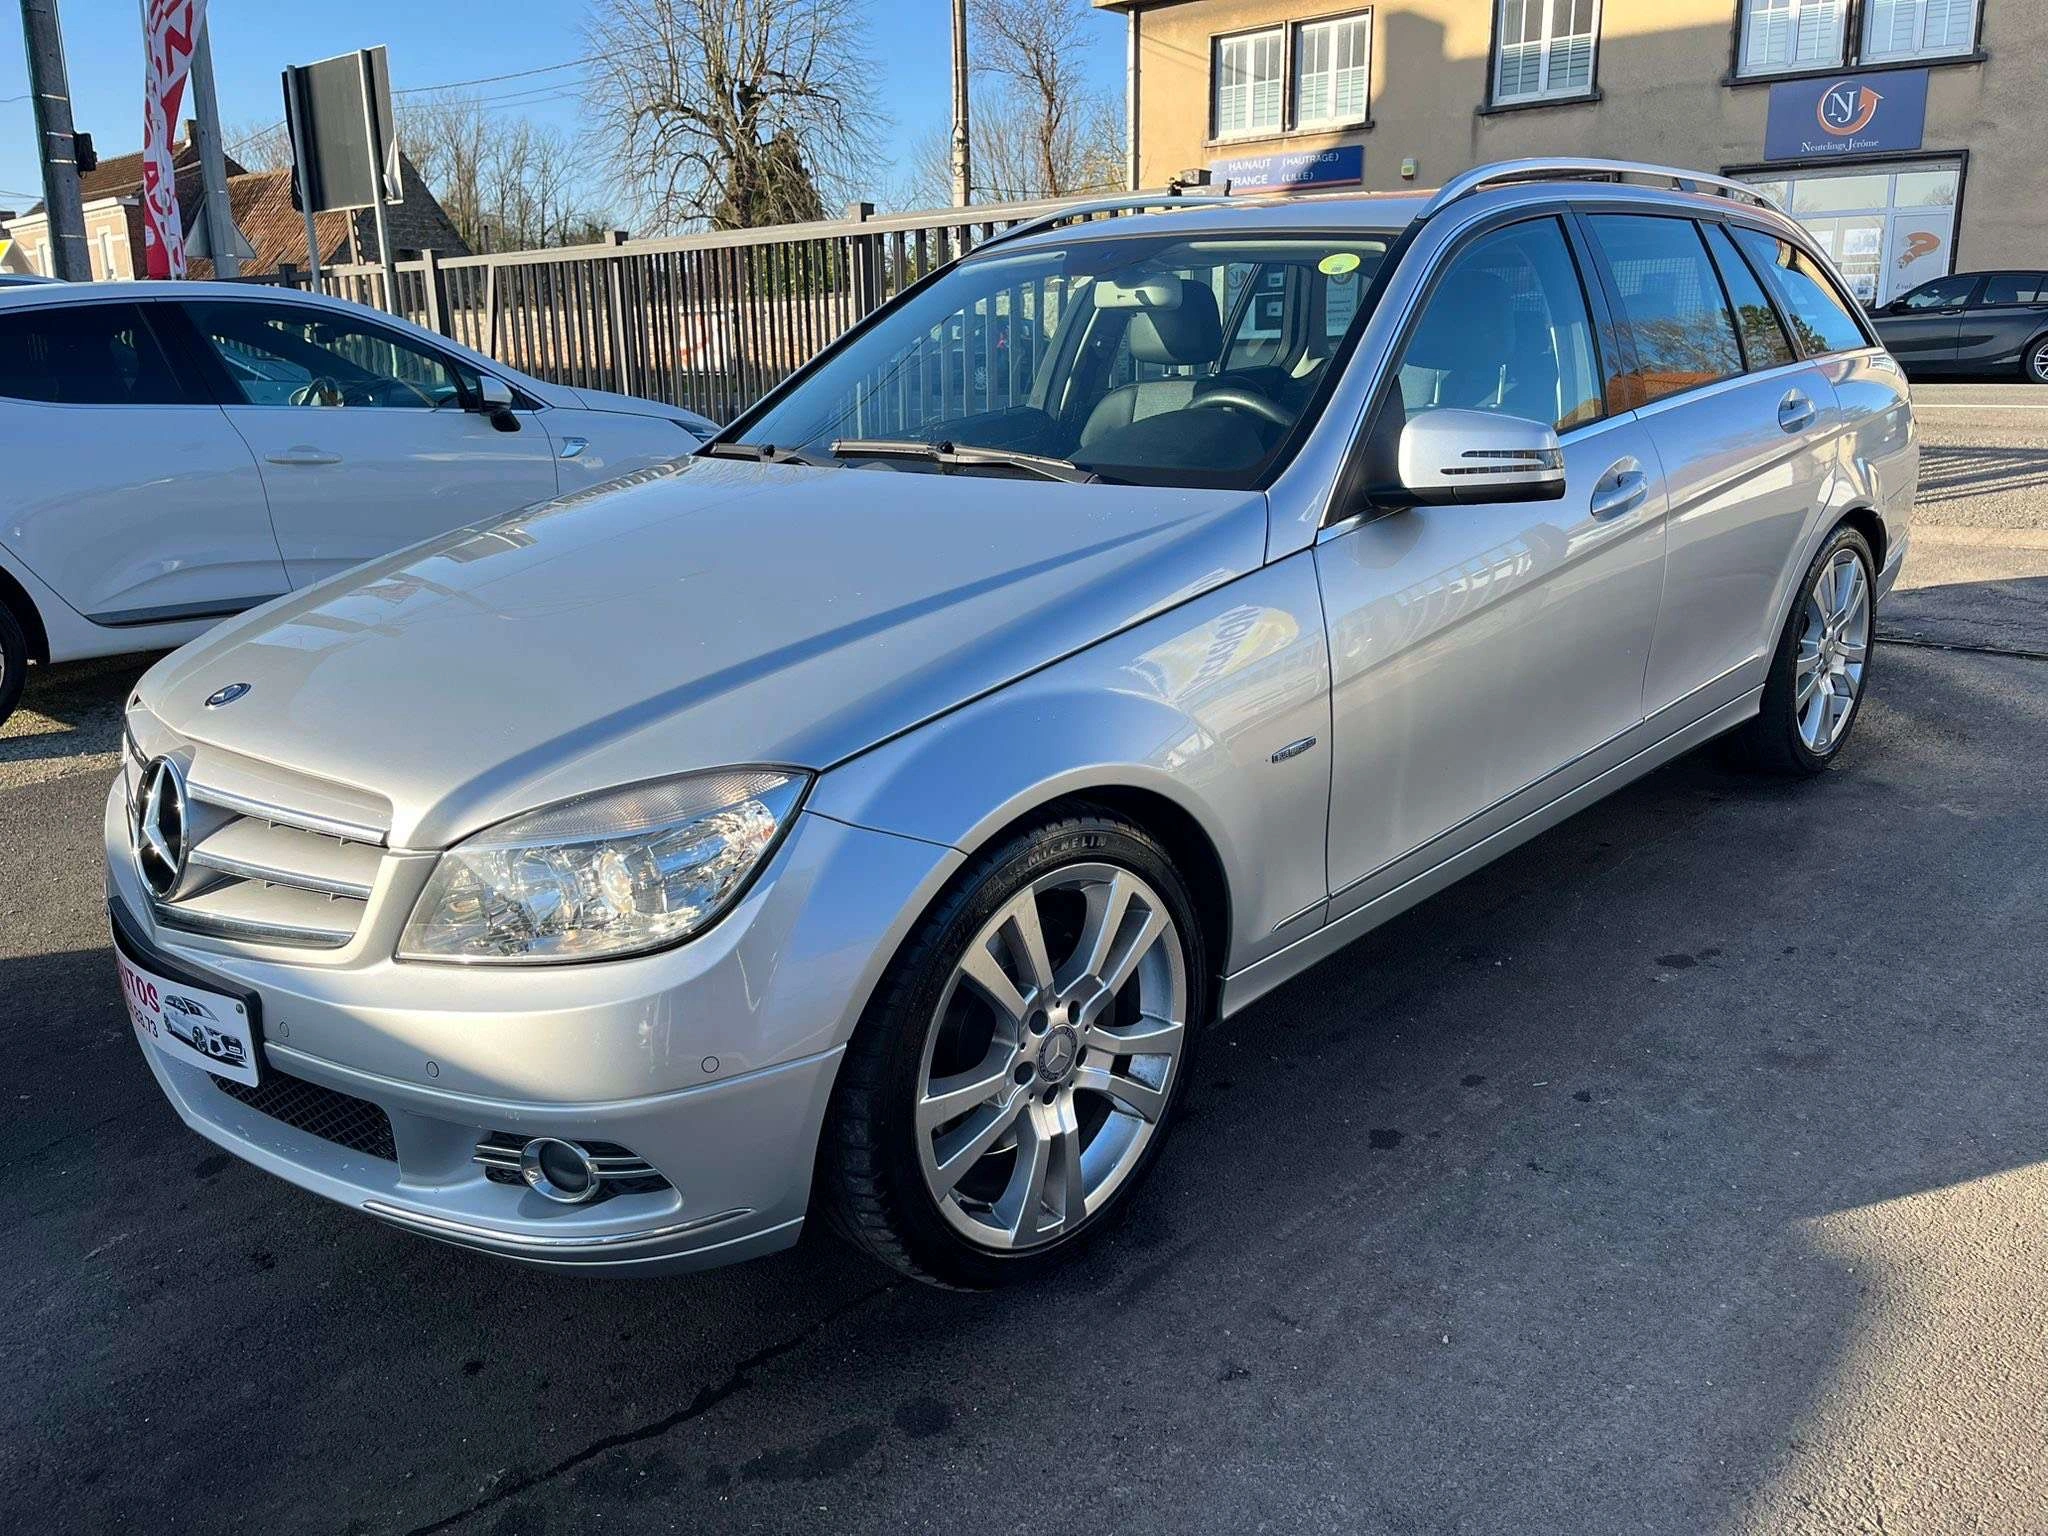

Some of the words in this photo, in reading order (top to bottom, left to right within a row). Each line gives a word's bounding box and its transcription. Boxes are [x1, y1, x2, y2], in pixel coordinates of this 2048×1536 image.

[1828, 90, 1857, 123] NJ
[1228, 158, 1272, 171] HAINAUT
[1281, 171, 1314, 183] (LILLE)
